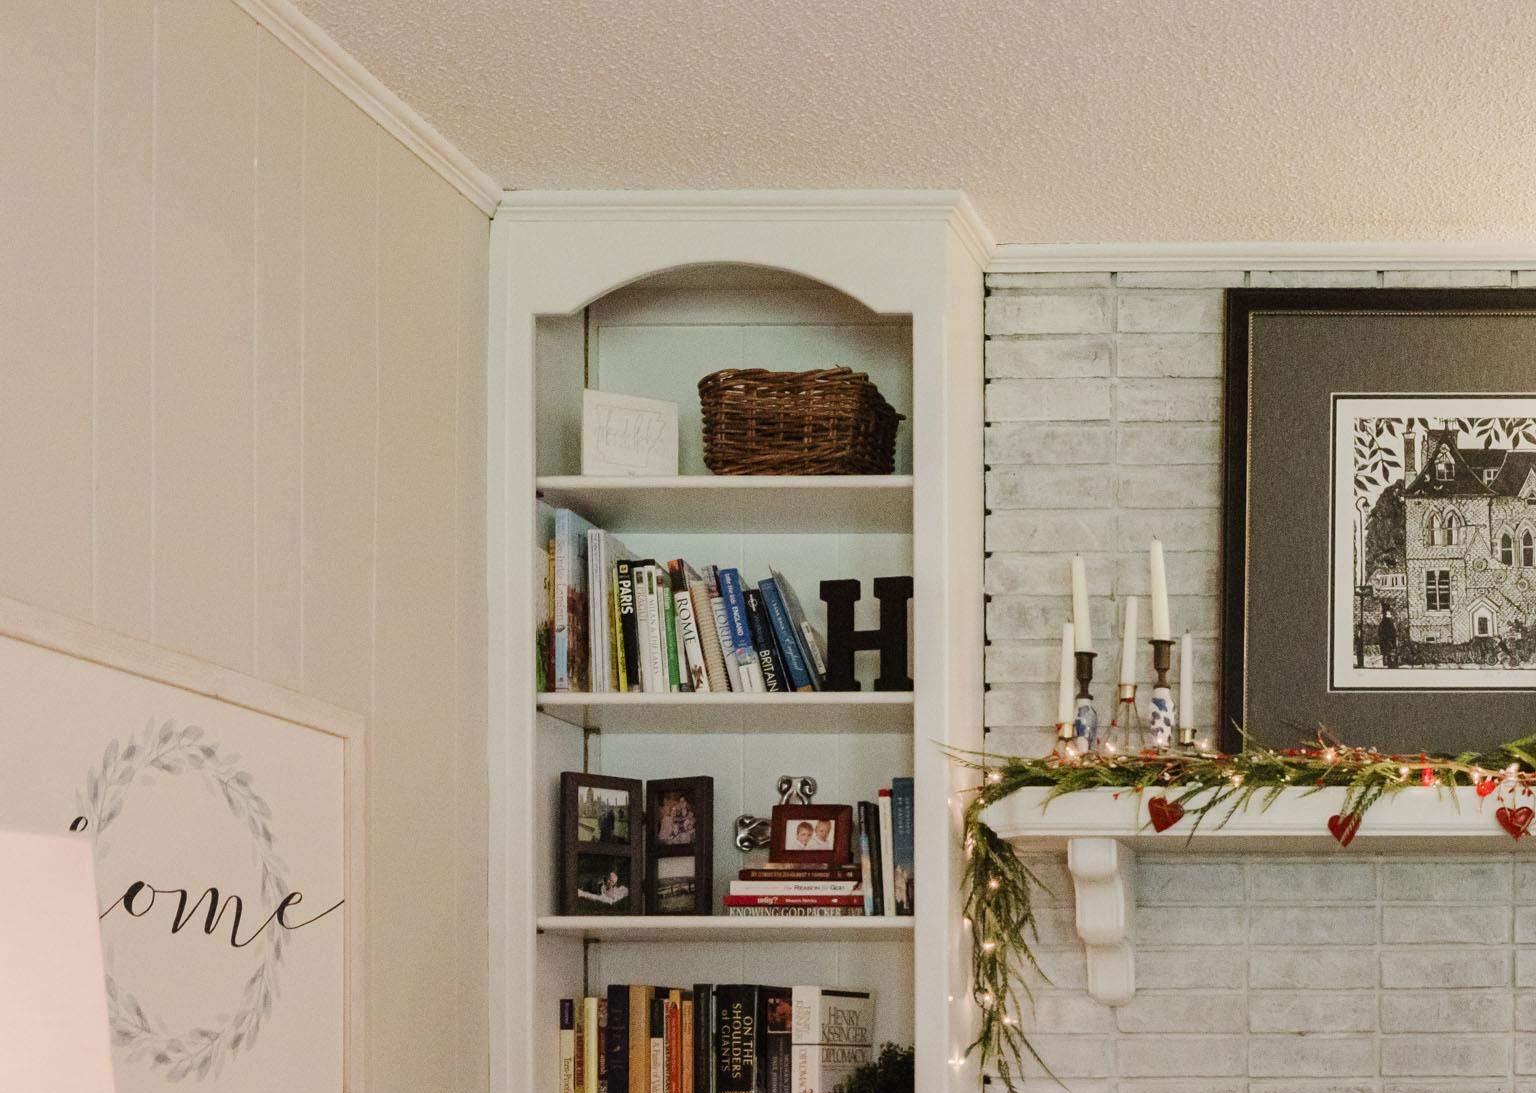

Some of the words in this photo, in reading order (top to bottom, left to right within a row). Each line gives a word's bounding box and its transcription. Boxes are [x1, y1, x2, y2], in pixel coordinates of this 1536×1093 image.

[619, 580, 633, 614] PARIS
[676, 598, 697, 645] ROME
[713, 601, 735, 657] FLORIDA
[732, 606, 744, 636] ENGLAND
[819, 576, 913, 691] H
[759, 649, 778, 692] BRITAIN
[730, 907, 779, 916] KNOWING
[781, 907, 806, 916] GOD
[721, 1009, 730, 1020] of
[743, 1016, 753, 1036] ON
[828, 1006, 861, 1027] HENRY
[721, 1025, 730, 1072] GIANTS
[732, 1003, 742, 1079] SHOULDERS
[821, 1023, 868, 1043] KISSINGER
[743, 1040, 753, 1065] THE
